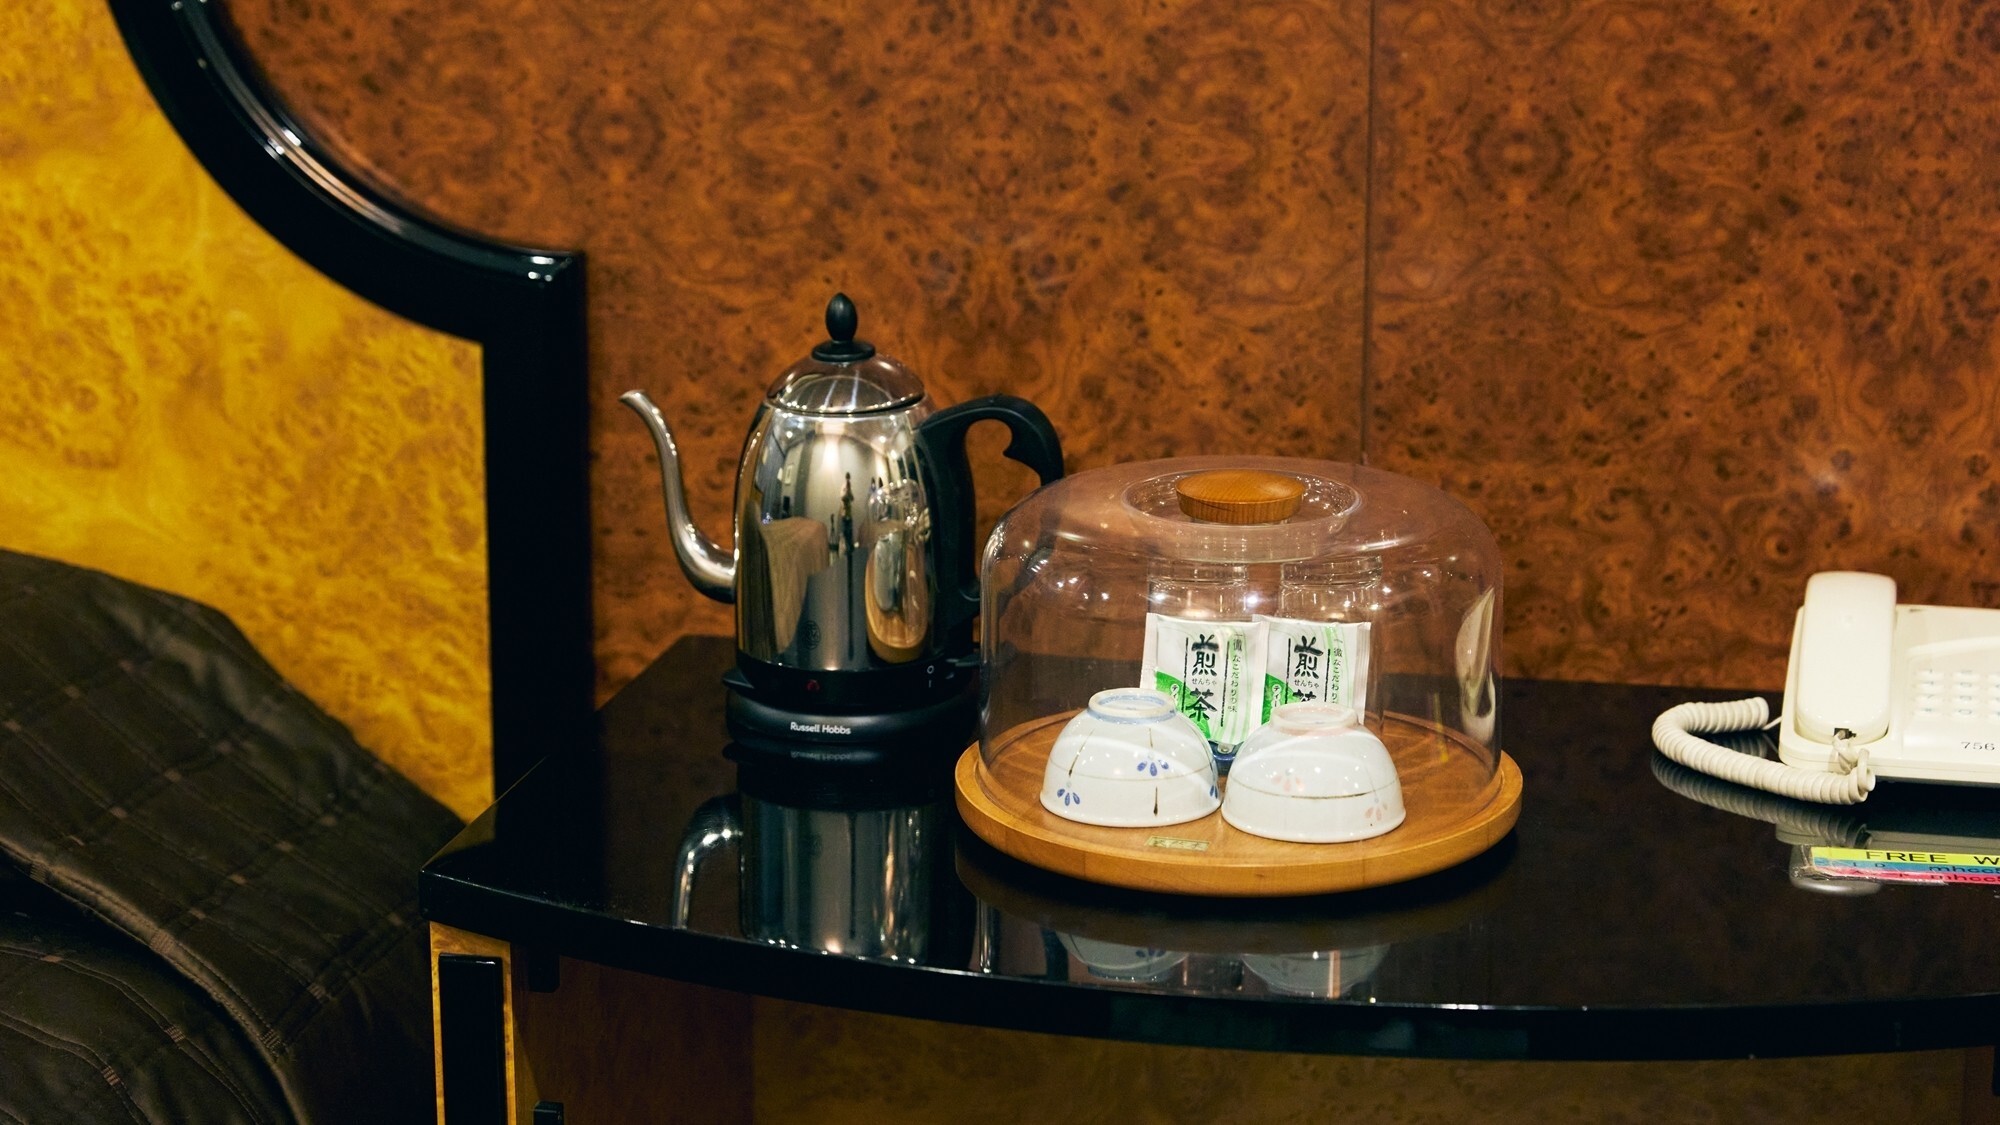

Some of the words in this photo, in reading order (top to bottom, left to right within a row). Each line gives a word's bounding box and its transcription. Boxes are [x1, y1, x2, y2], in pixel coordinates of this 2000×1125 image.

[1186, 633, 1219, 722] 煎茶
[1191, 677, 1218, 686] せんちゃ
[1293, 679, 1320, 689] せんちゃ
[790, 721, 820, 733] Russell
[822, 724, 851, 735] Hobbs
[1961, 741, 1995, 751] 756
[1866, 851, 1948, 864] FREE
